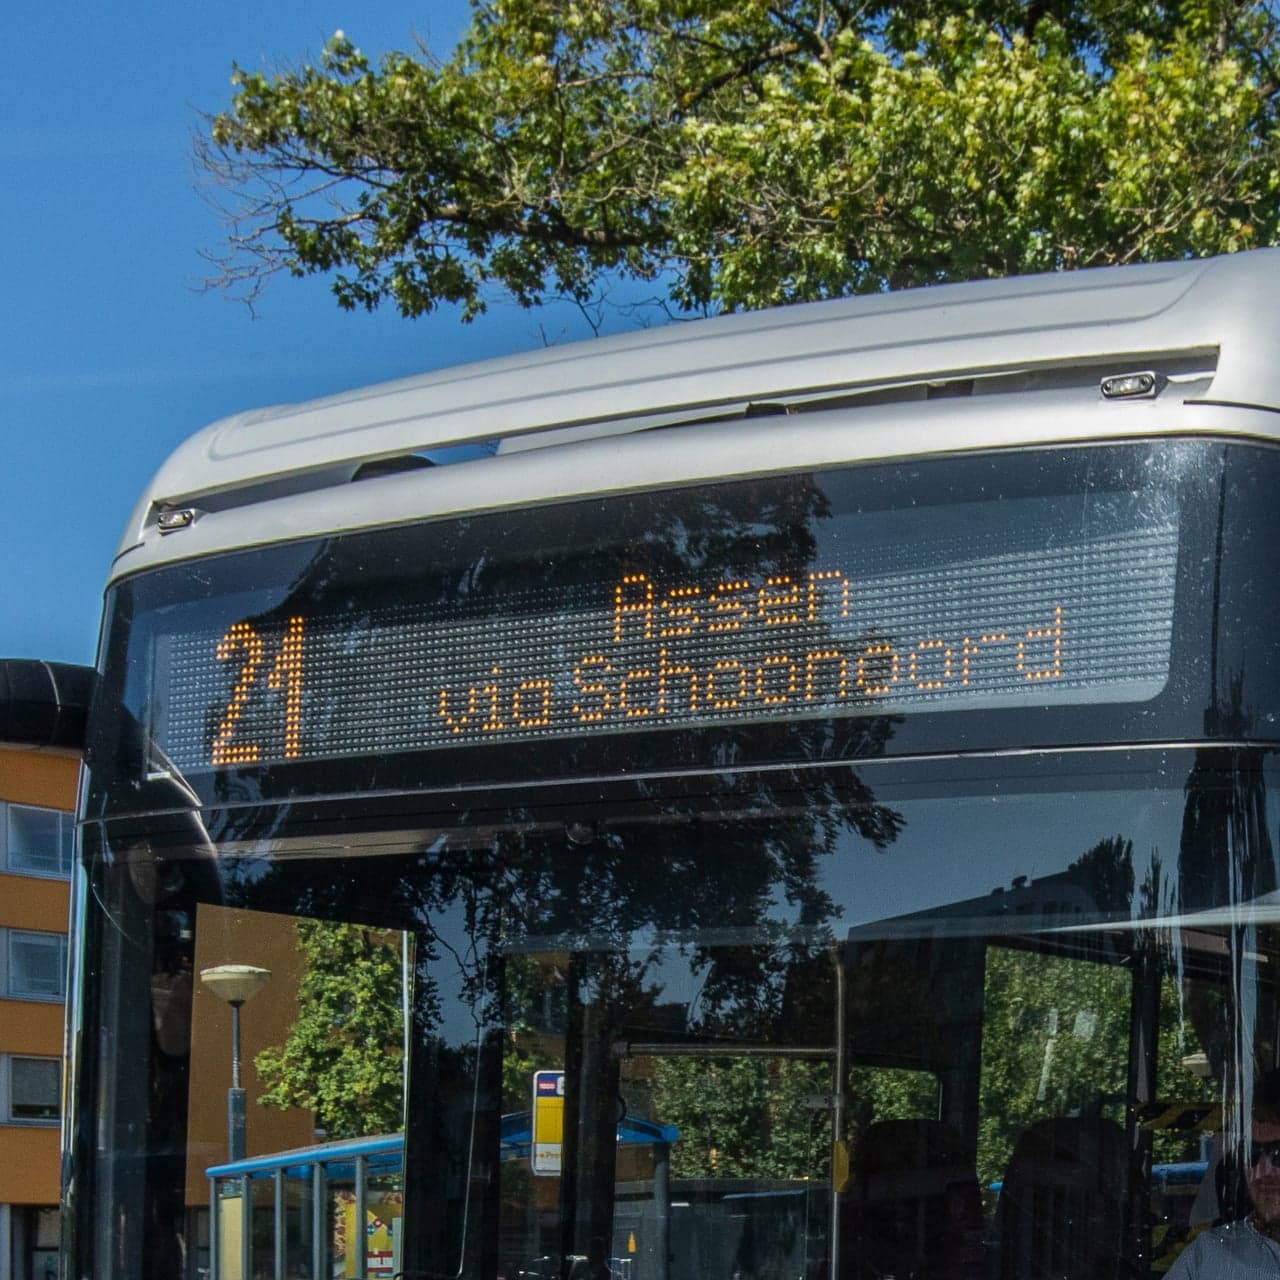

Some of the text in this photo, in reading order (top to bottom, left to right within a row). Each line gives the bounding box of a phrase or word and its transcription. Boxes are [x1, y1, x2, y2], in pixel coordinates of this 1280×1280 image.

[440, 605, 1062, 734] via Schoonoord
[614, 568, 850, 643] Assen
[211, 615, 304, 766] 21
